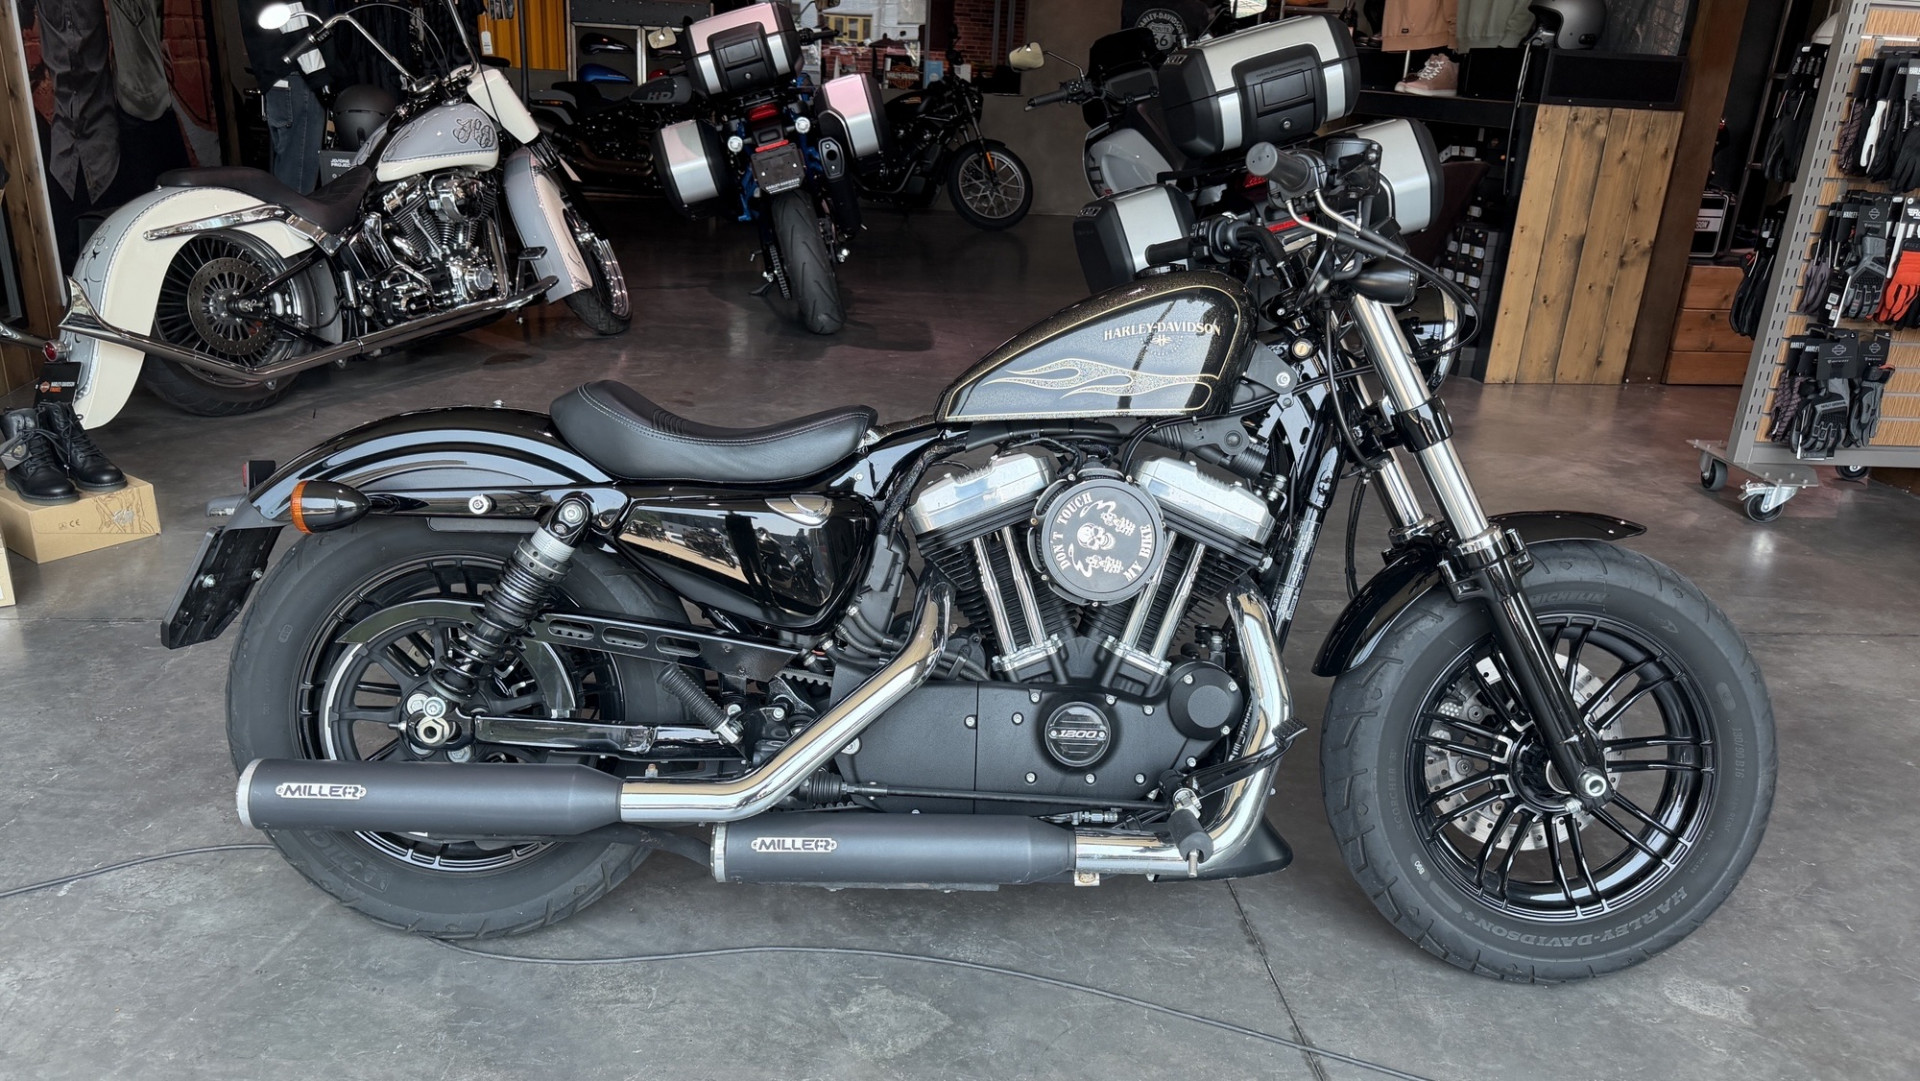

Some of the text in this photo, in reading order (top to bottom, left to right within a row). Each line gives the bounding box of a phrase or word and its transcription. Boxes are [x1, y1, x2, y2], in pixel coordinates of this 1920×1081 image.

[1104, 319, 1221, 341] HARLEY-DAVIDSON
[1051, 492, 1093, 571] DON'T TOUCH
[1122, 523, 1153, 582] MY BIKE
[1058, 729, 1098, 739] 1200
[283, 784, 360, 798] MILLER
[758, 838, 831, 851] MILLER
[1474, 886, 1689, 948] HARLEY-DAVIDSON
